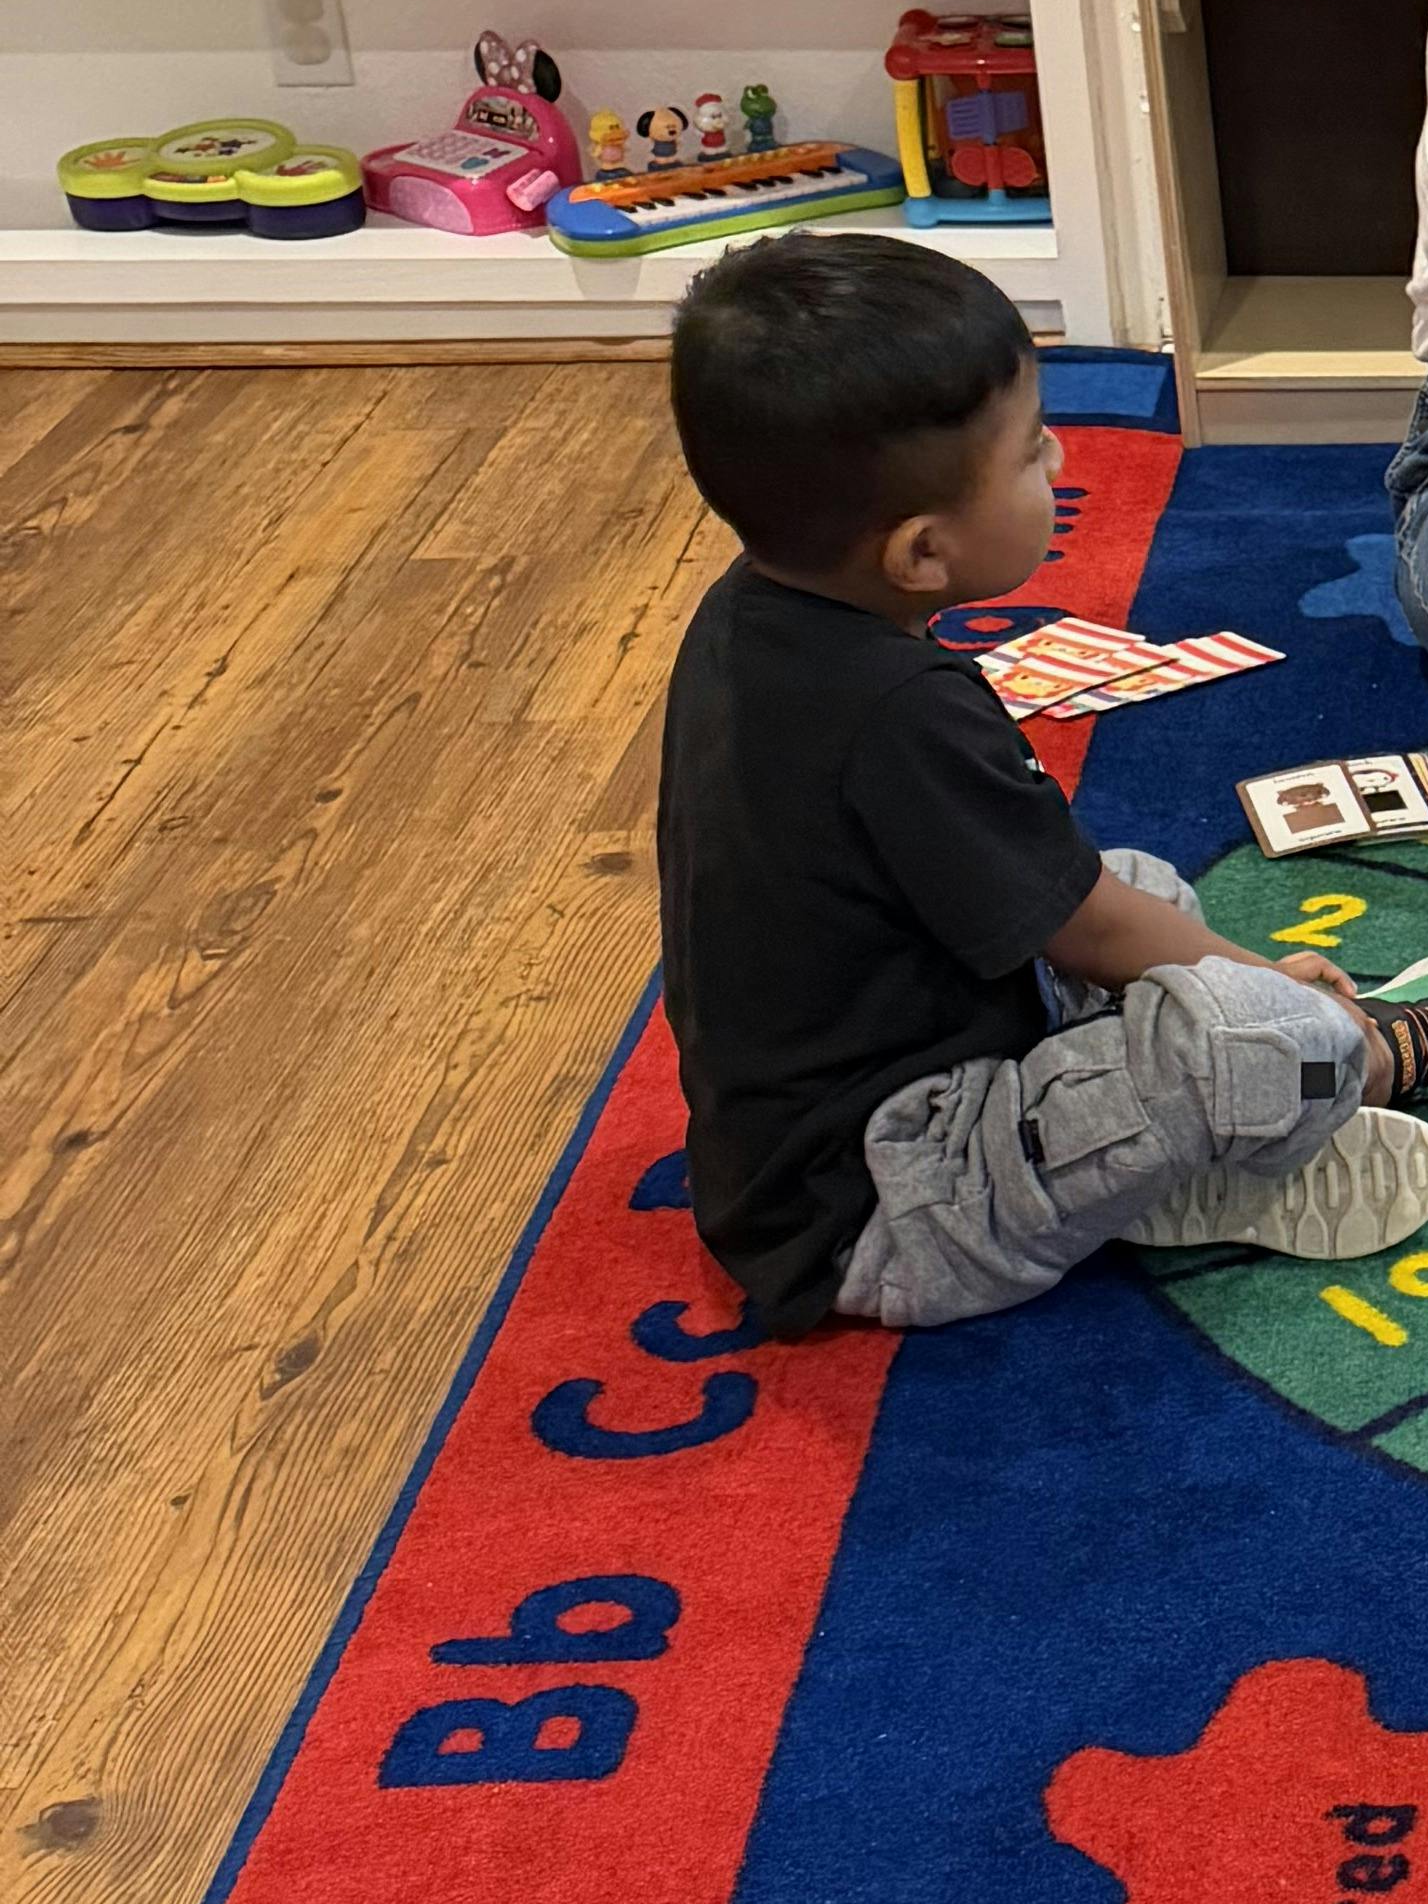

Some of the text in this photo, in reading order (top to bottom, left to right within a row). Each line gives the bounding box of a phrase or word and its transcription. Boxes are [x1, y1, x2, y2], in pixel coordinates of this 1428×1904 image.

[1271, 893, 1367, 948] 2
[378, 1573, 682, 1788] Bb
[531, 1296, 772, 1459] Cc
